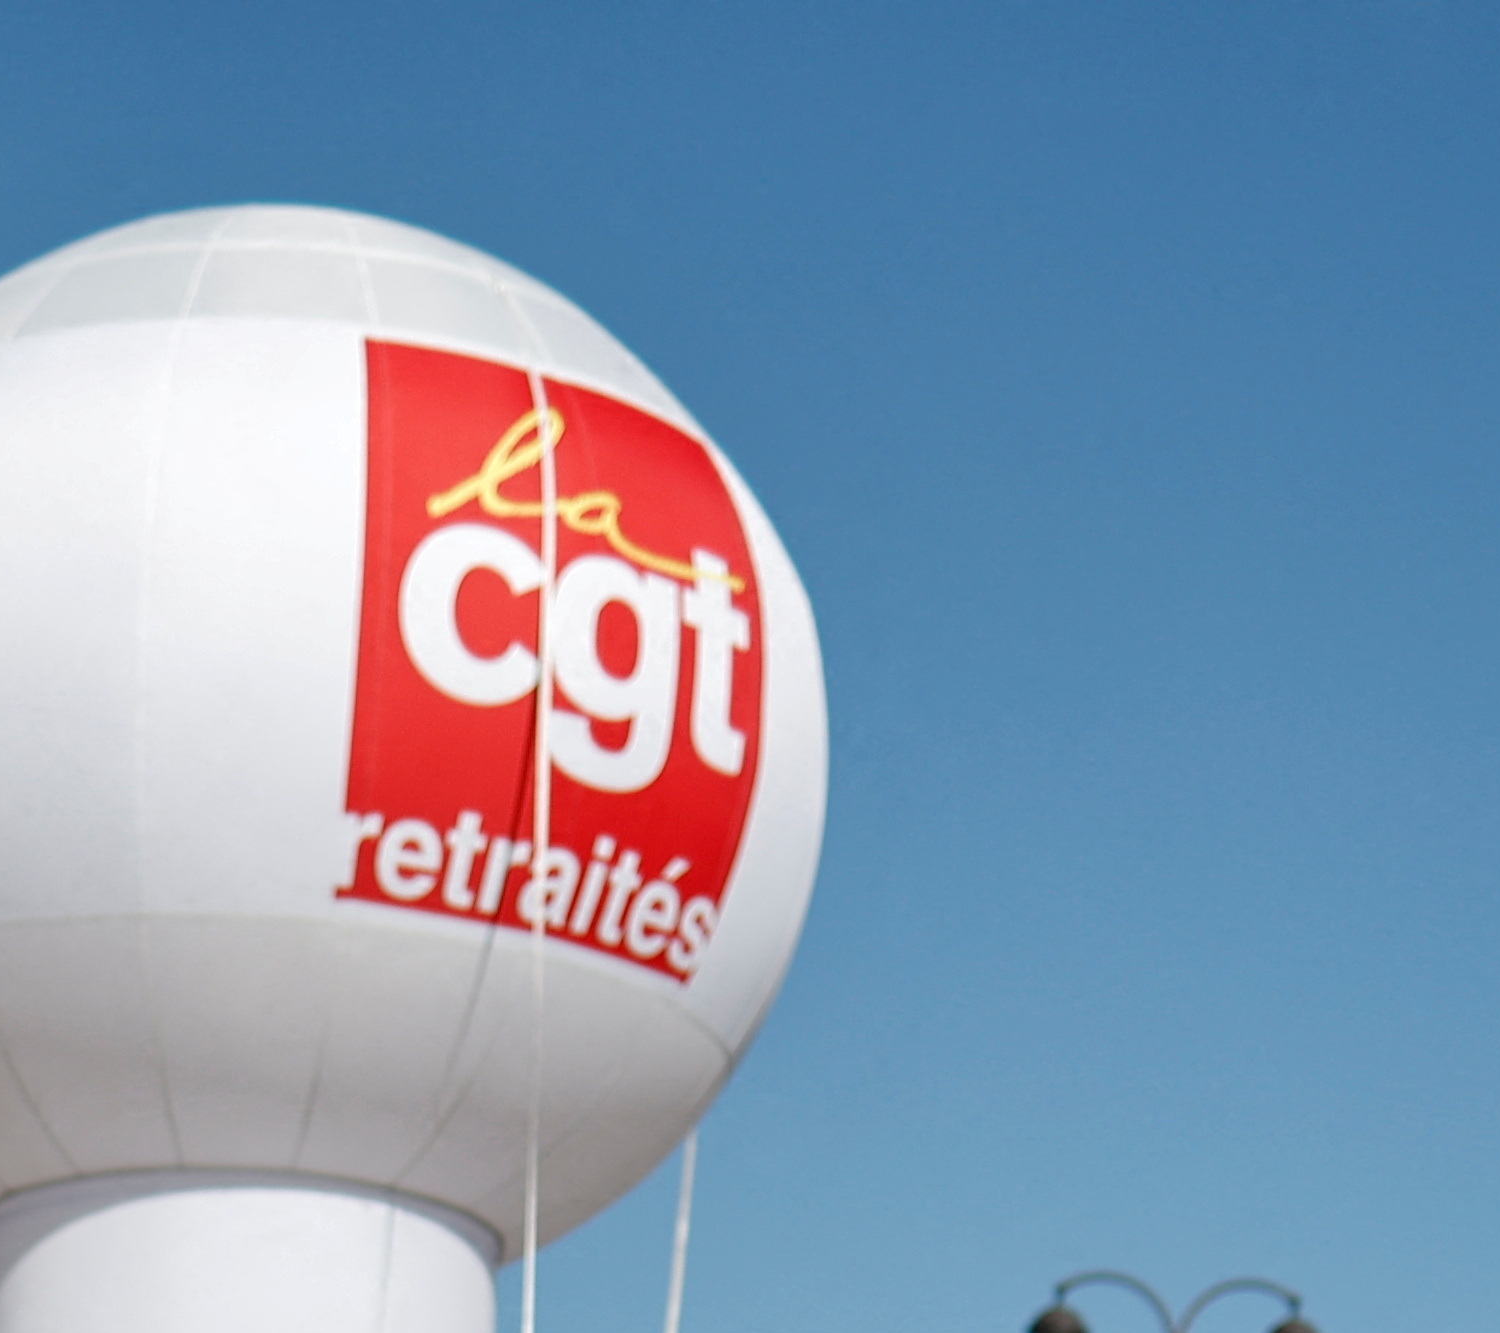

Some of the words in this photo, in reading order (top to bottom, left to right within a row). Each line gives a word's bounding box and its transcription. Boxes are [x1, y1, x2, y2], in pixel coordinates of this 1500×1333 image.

[425, 407, 746, 593] la
[399, 523, 751, 793] cgt
[335, 809, 720, 974] retraités
